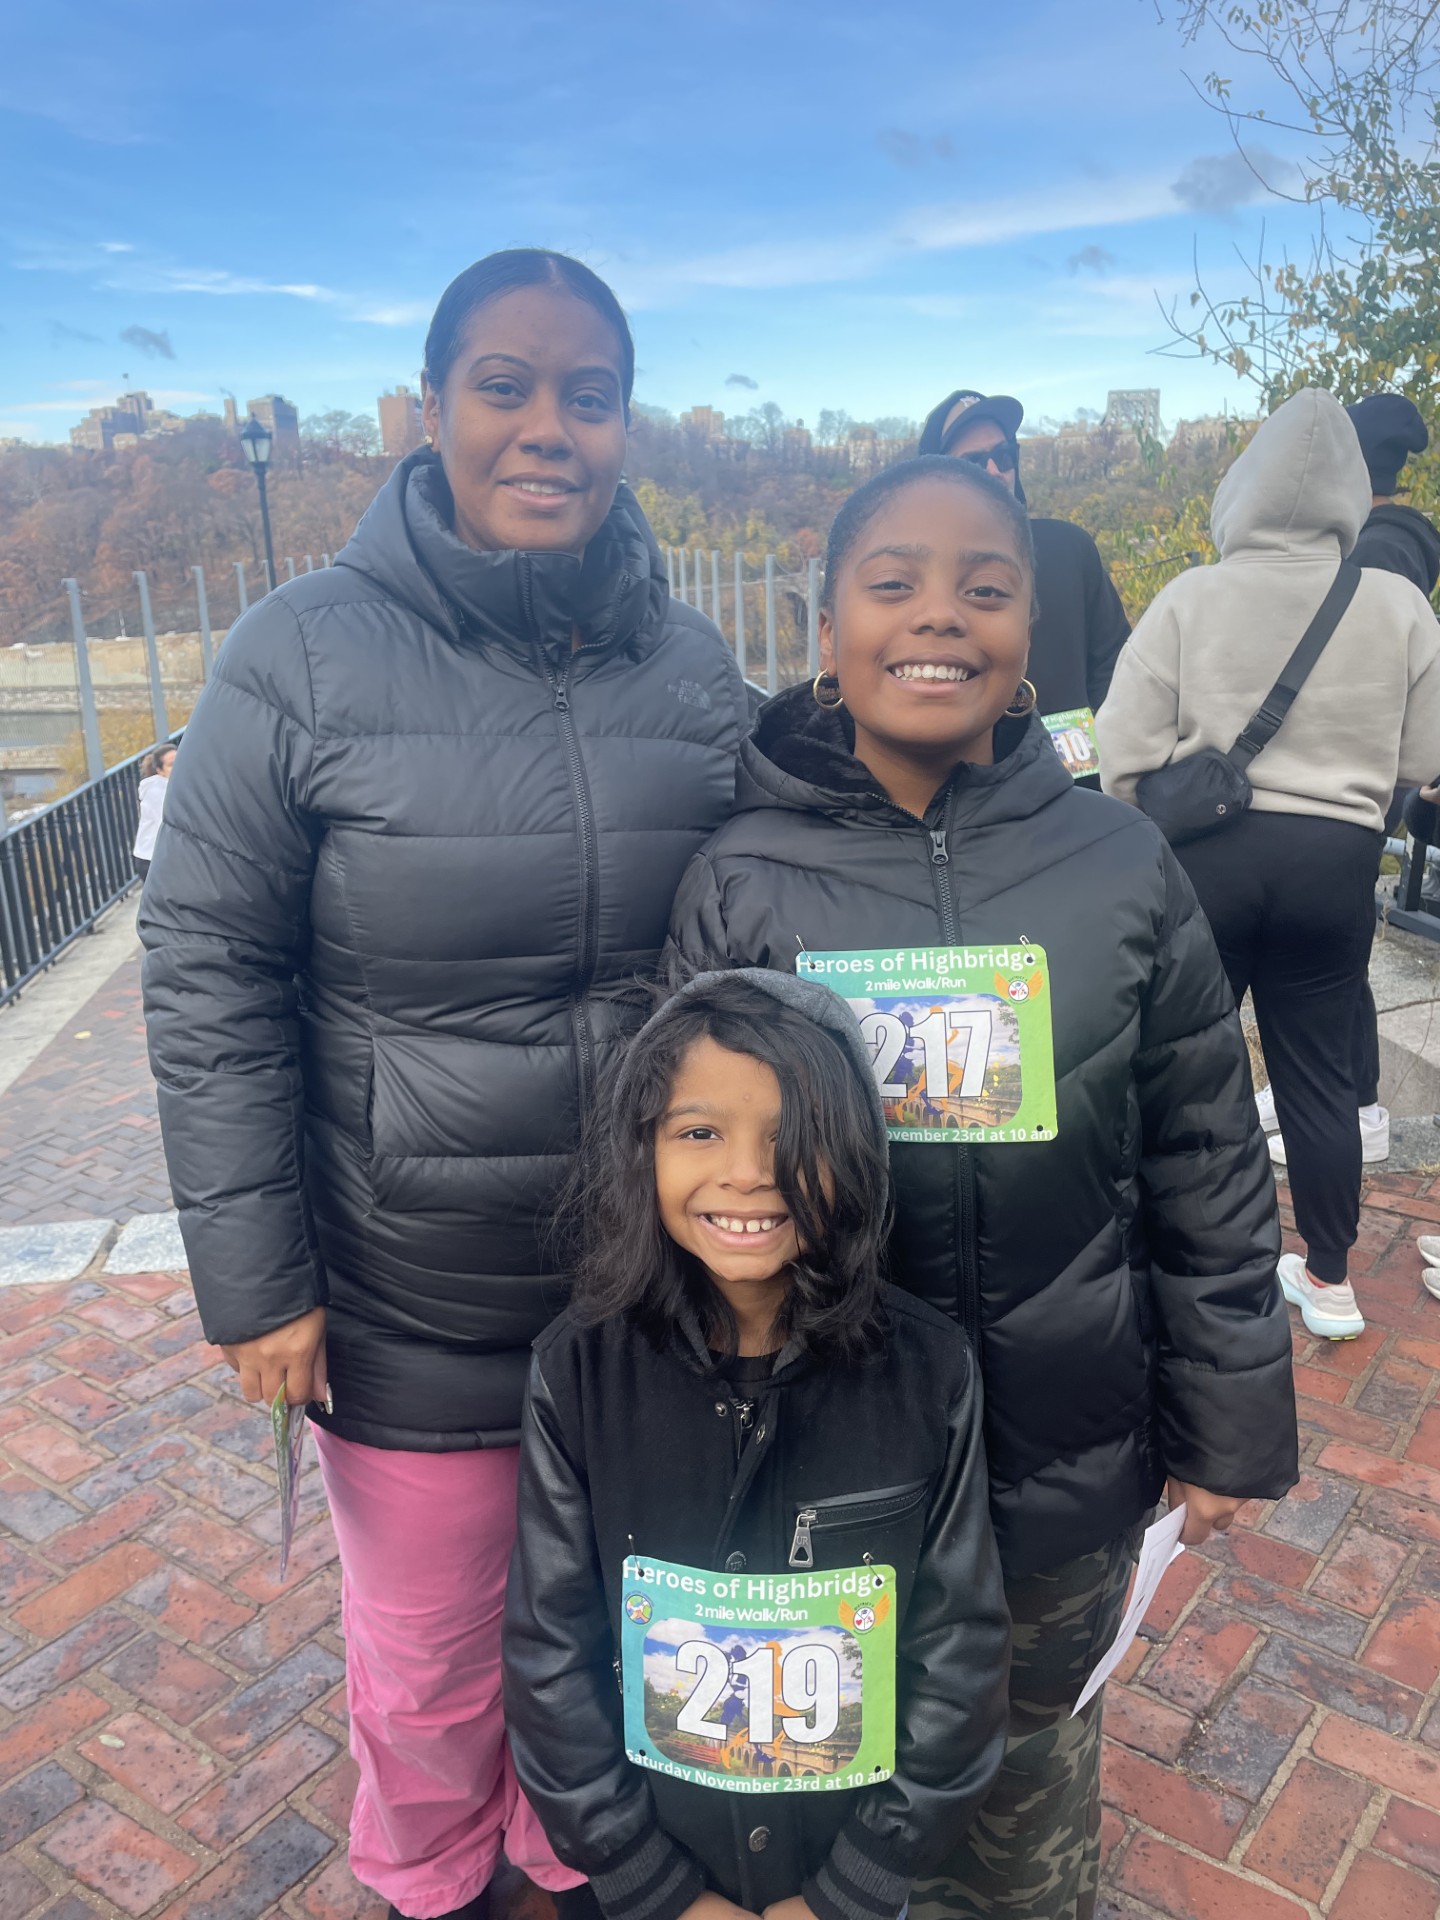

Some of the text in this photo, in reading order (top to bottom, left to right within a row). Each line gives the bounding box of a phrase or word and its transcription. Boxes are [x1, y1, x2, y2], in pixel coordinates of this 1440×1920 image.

[1057, 731, 1091, 764] 10
[795, 948, 1036, 974] Heroes of Highbridge
[865, 977, 967, 992] 2 mile Walk/Run
[858, 1010, 992, 1098] 217
[887, 1128, 1054, 1141] ovember 23rd at 10 am
[623, 1559, 885, 1605] Heroes of Highbridge
[695, 1604, 809, 1622] 2 mile Walk/Run
[675, 1640, 840, 1744] 219
[625, 1749, 890, 1792] Saturday November 23rd at 10 am
